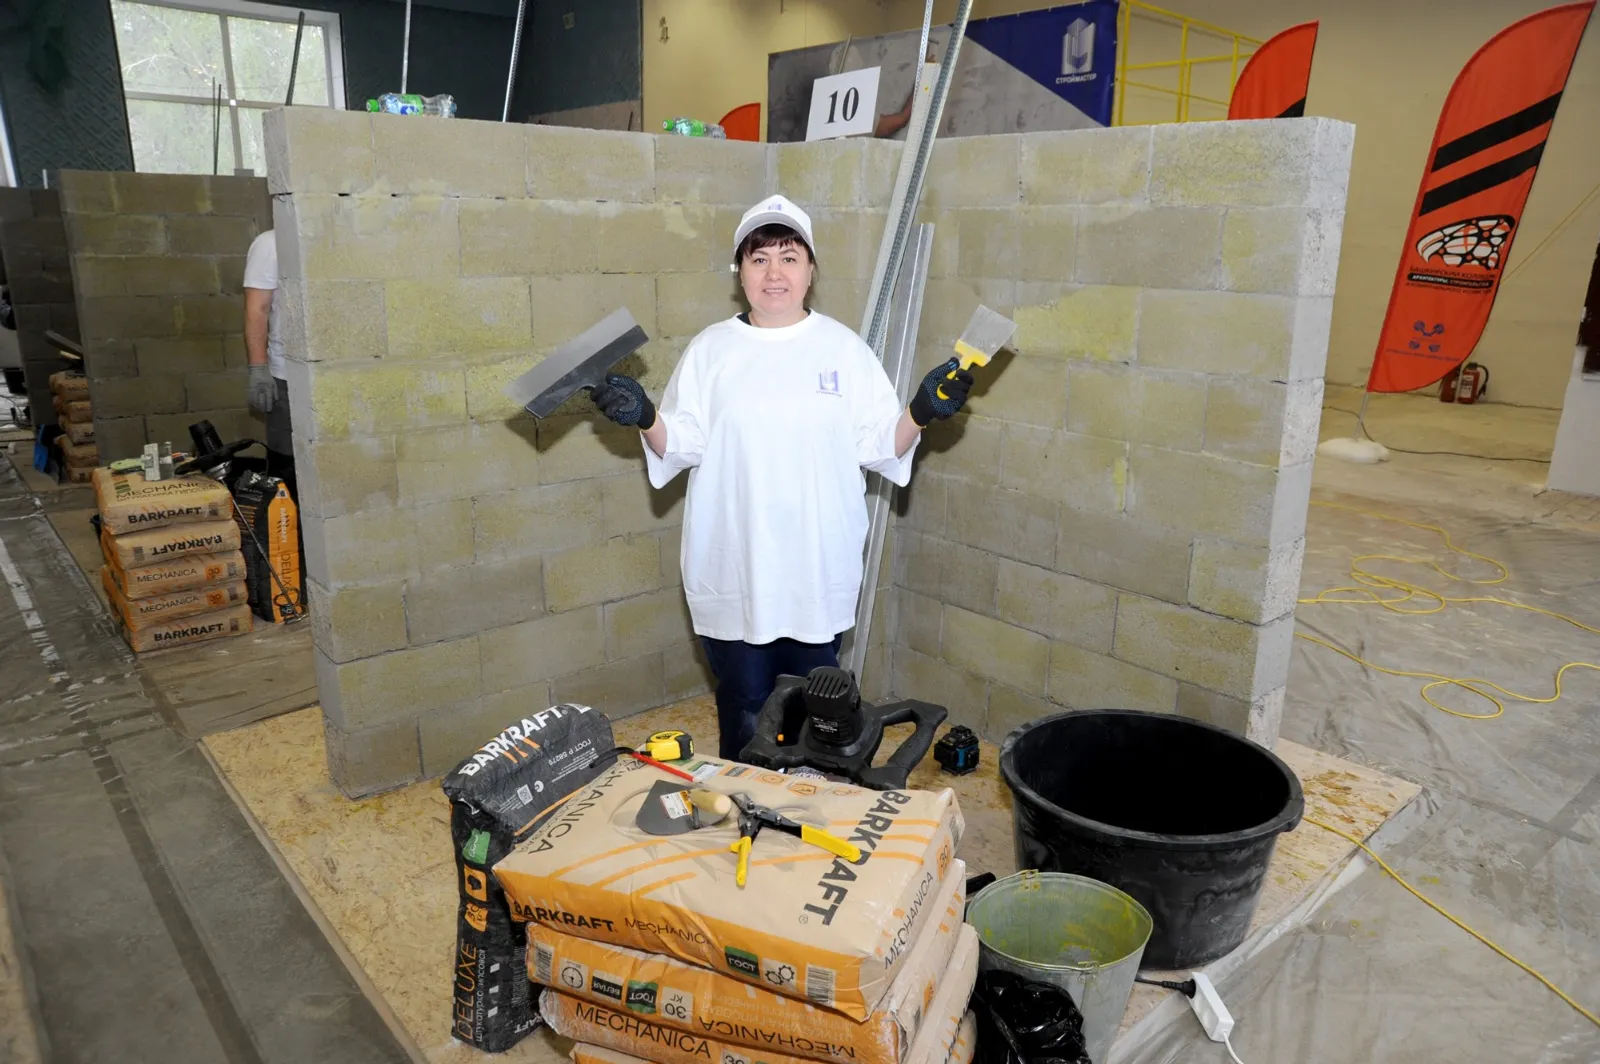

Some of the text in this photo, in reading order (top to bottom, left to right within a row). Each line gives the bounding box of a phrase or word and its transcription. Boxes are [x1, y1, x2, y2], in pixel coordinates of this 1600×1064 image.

[1055, 73, 1097, 85] СТРОЙМАСТЕР
[824, 86, 859, 124] 10
[151, 535, 222, 556] BARKRAFT
[137, 566, 220, 583] MECHANICA 30
[140, 595, 200, 614] MECHANICA
[154, 623, 224, 641] BARKRAFT
[458, 704, 563, 777] BARKRAFT
[572, 738, 592, 752] ГОСТ
[527, 758, 648, 855] HANICA
[884, 871, 934, 970] MECHANICA
[478, 949, 486, 988] ипсовая
[728, 957, 757, 972] ГОСТ
[456, 940, 477, 1040] DELUXE
[592, 980, 621, 996] БЕЛАЯ
[628, 991, 655, 1004] ГОСТ
[664, 1002, 688, 1019] 30
[574, 1002, 712, 1059] MECHANICA
[699, 1016, 856, 1059] MECHANICA
